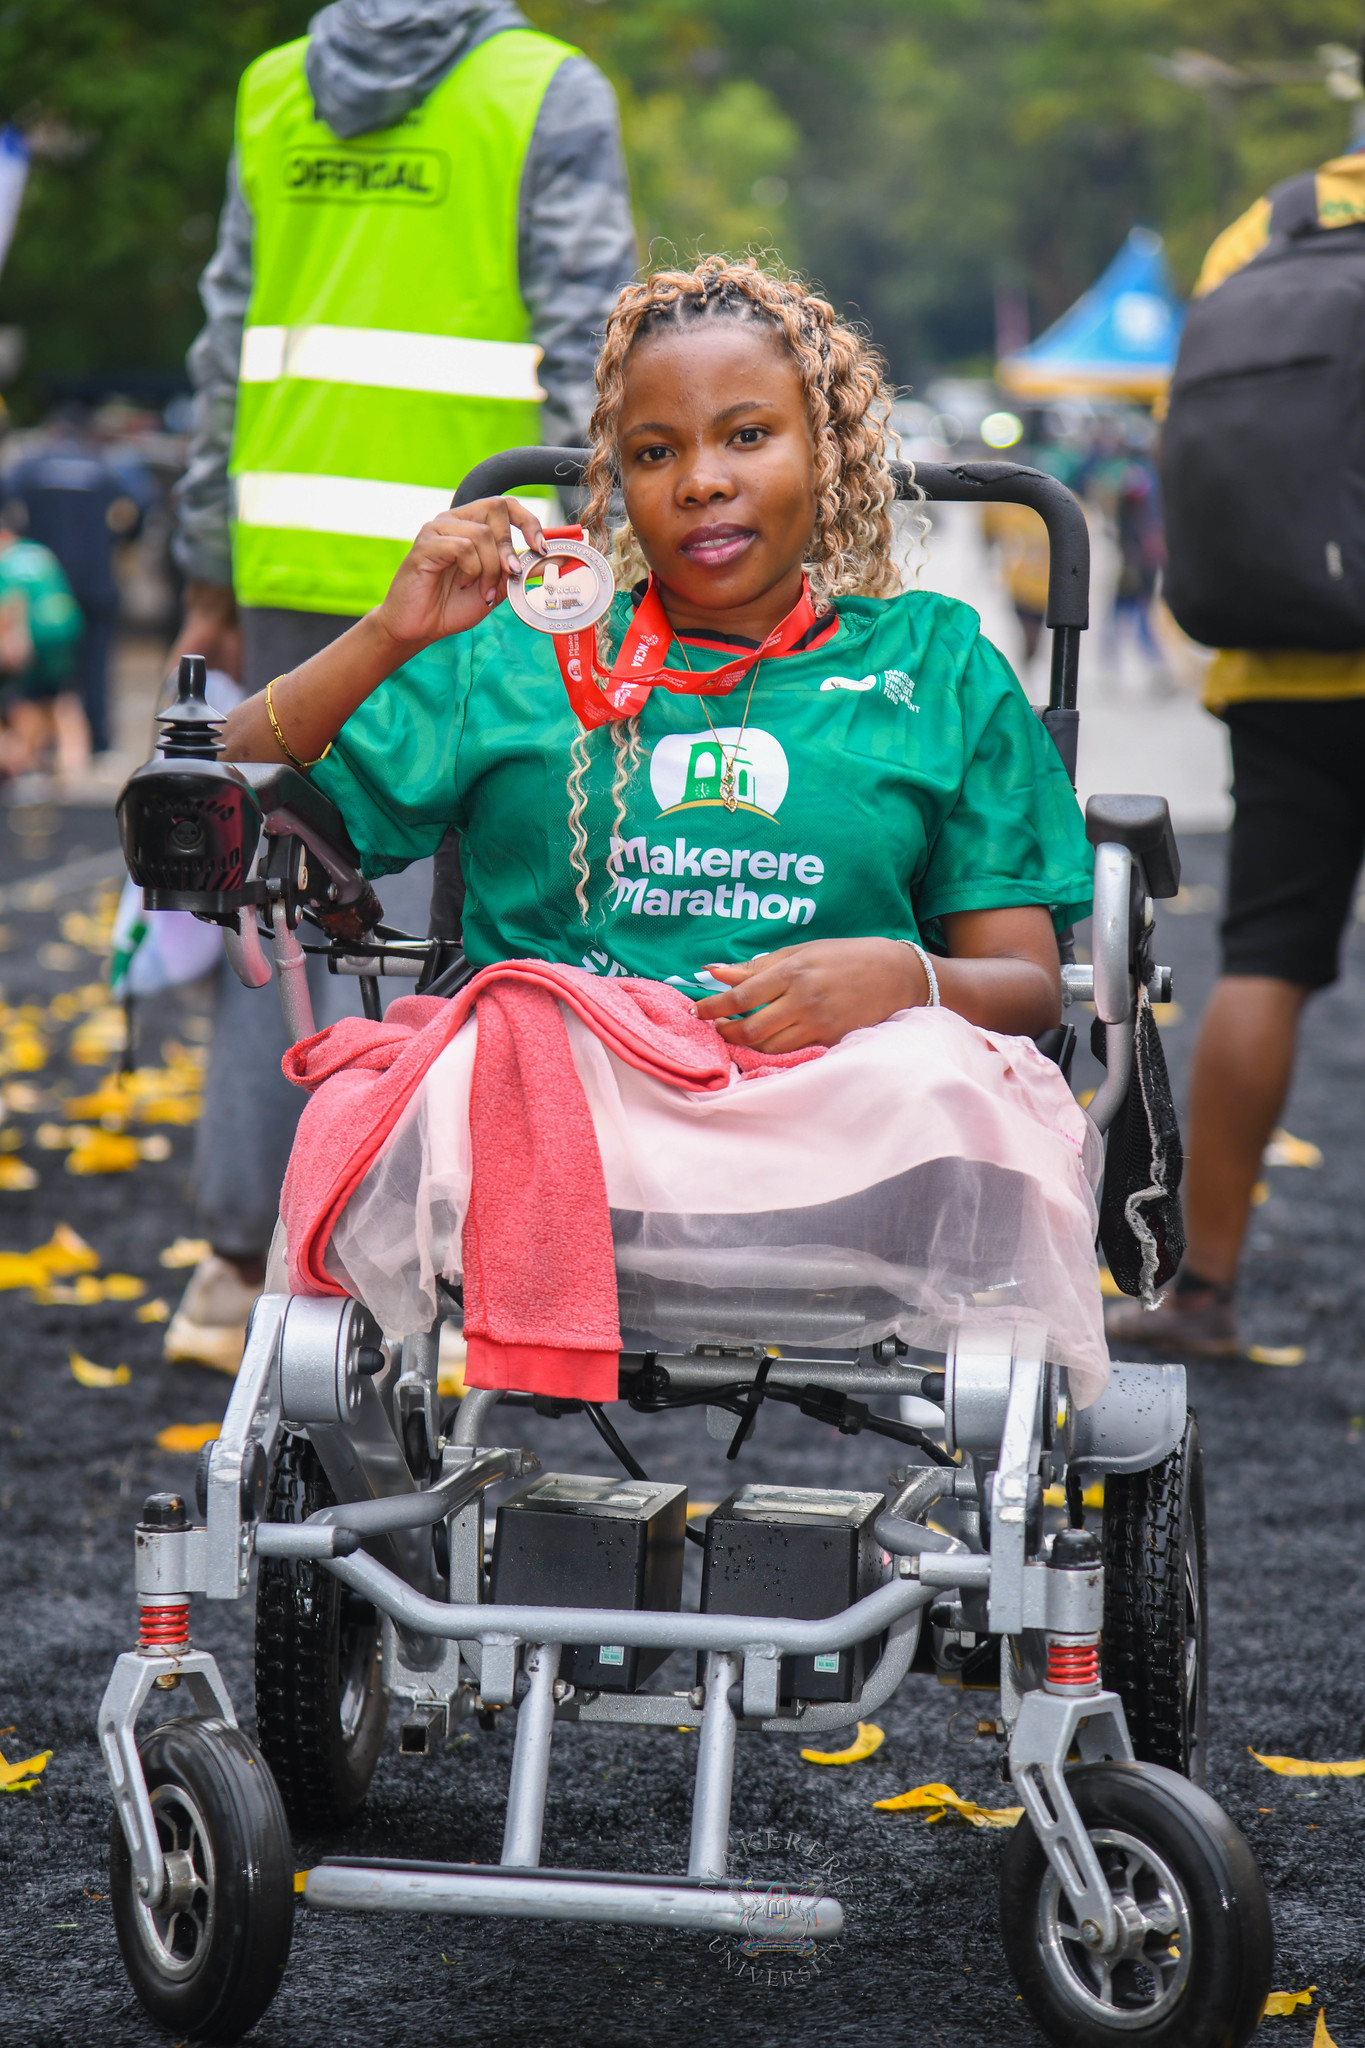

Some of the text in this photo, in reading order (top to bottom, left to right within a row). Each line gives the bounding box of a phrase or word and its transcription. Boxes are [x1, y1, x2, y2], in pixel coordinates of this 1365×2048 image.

[631, 642, 649, 667] NCBA
[883, 687, 898, 705] FUND
[609, 836, 824, 885] Makerere
[611, 877, 816, 924] Marathon
